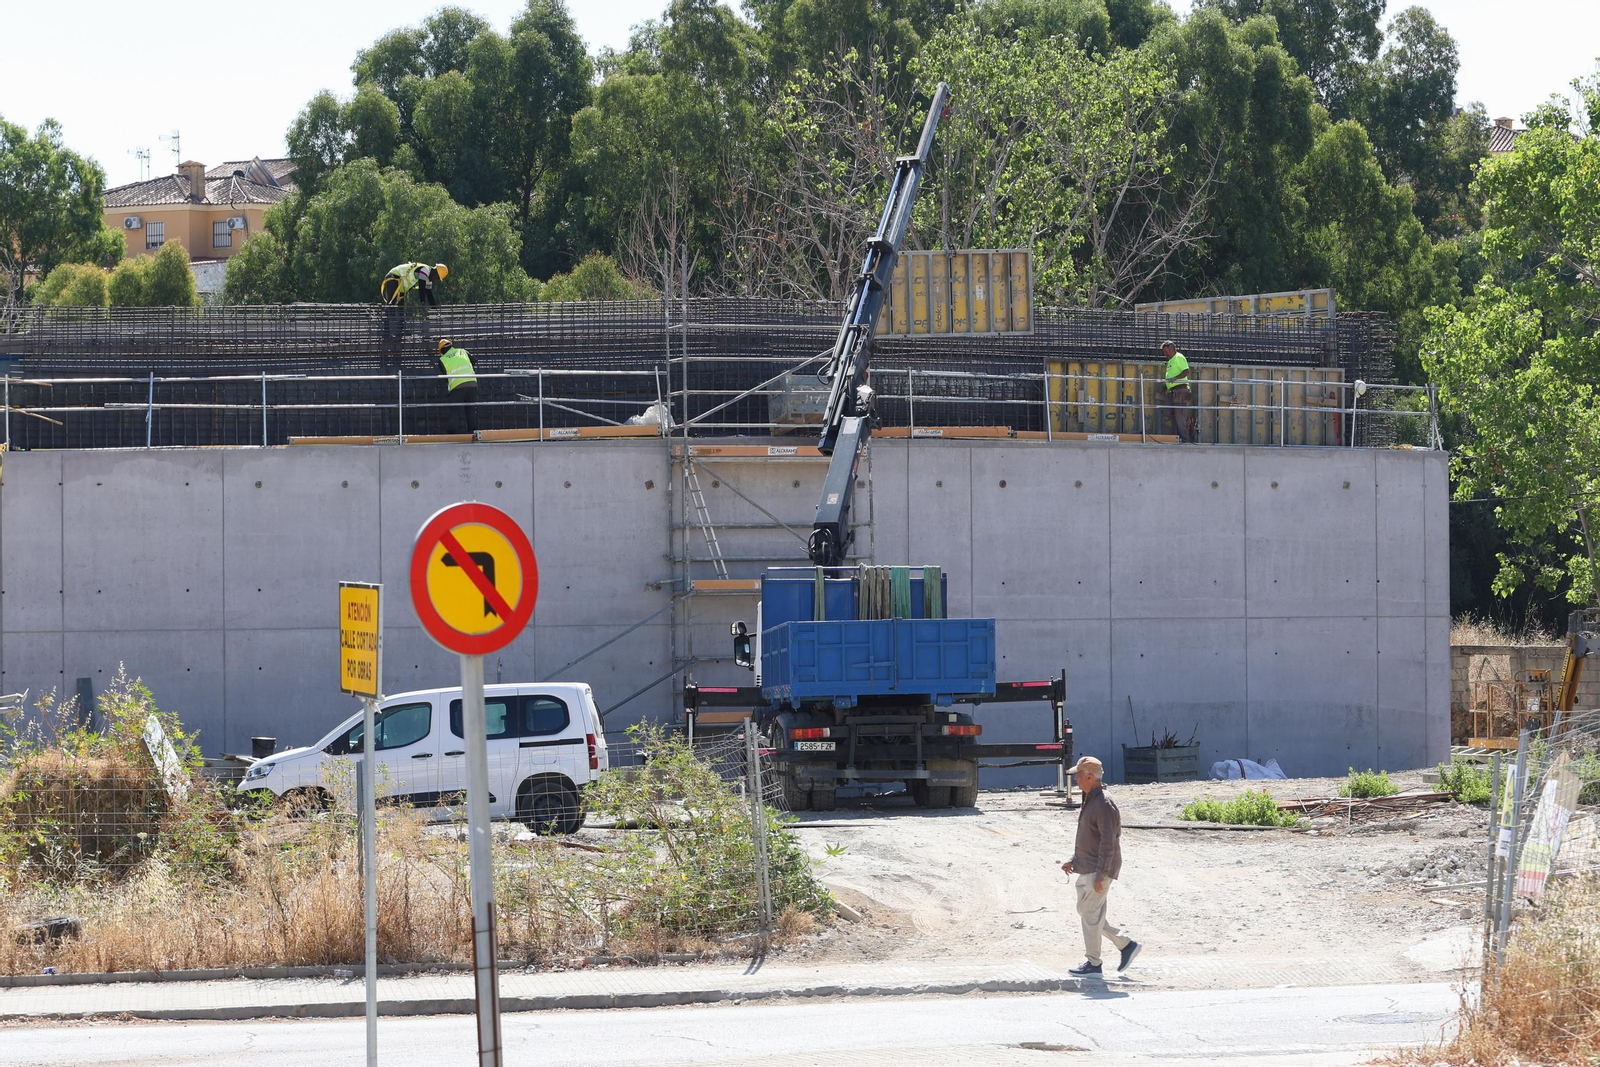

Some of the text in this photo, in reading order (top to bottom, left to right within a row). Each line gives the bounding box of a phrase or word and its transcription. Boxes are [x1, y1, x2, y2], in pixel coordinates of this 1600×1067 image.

[348, 596, 372, 622] ATENCIÓN
[341, 629, 377, 652] CALLE CORTADA
[347, 659, 372, 681] POR OBRAS
[800, 743, 818, 751] 2585
